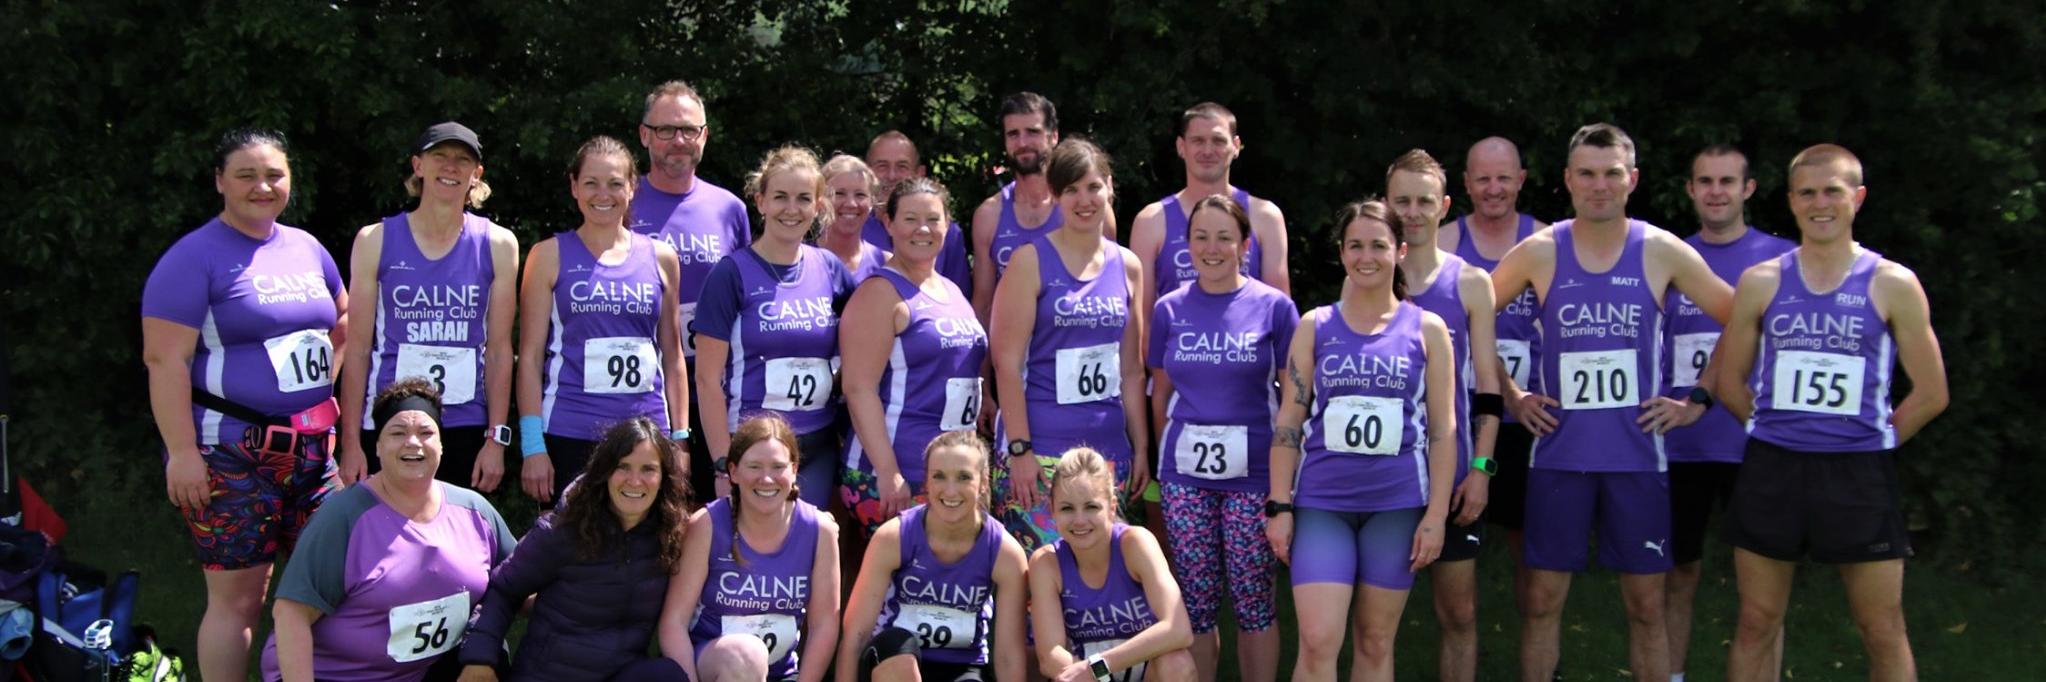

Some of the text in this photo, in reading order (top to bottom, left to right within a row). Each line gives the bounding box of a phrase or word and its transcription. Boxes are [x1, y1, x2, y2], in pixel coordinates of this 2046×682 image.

[570, 280, 655, 303] CALNE
[1611, 276, 1641, 287] MATT
[257, 292, 307, 305] Running
[392, 284, 480, 307] CALNE
[1054, 295, 1125, 316] CALNE
[394, 306, 477, 321] Running Club
[571, 302, 653, 315] Running Club
[758, 297, 832, 320] CALNE
[1506, 303, 1532, 316] Club
[1558, 302, 1643, 326] CALNE
[406, 321, 469, 343] SARAH
[760, 319, 812, 332] Running
[1054, 314, 1124, 329] Running Club
[1561, 323, 1639, 338] Running Club
[1771, 312, 1864, 339] CALNE
[1178, 331, 1258, 351] CALNE
[1827, 335, 1860, 352] Club
[290, 346, 329, 384] 164
[1174, 350, 1258, 364] Running Club
[1321, 353, 1412, 379] CALNE
[429, 364, 446, 396] 3
[607, 355, 641, 388] 98
[1078, 362, 1107, 396] 66
[1322, 375, 1406, 390] Running Club
[787, 374, 817, 407] 42
[1573, 368, 1628, 403] 210
[1792, 369, 1849, 408] 155
[1345, 413, 1383, 449] 60
[1193, 442, 1227, 474] 23
[719, 571, 808, 599] CALNE
[902, 575, 988, 605] CALNE
[715, 591, 804, 611] Running Club
[1064, 596, 1149, 629] CALNE
[412, 617, 449, 654] 56
[917, 622, 952, 649] 39
[1119, 619, 1152, 634] Club
